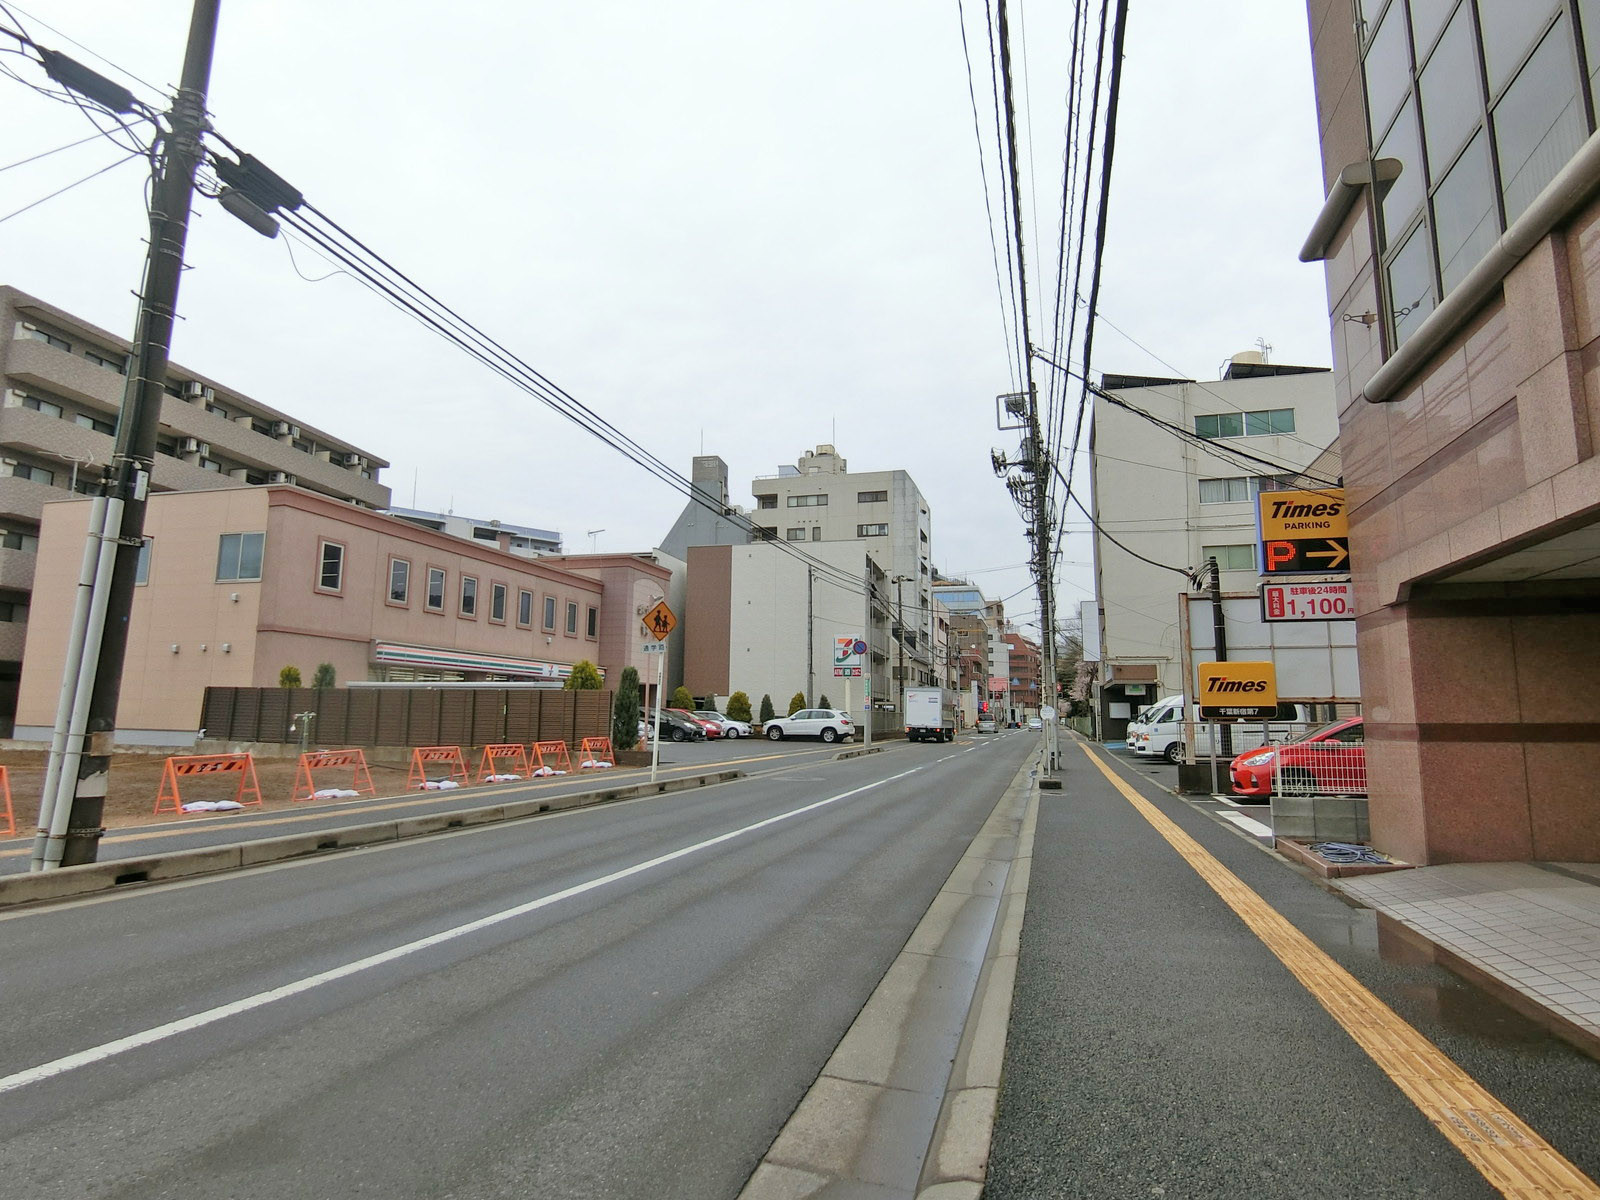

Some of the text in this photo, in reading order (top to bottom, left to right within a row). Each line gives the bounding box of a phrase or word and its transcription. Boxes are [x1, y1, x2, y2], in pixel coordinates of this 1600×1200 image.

[1271, 501, 1343, 519] Times
[1284, 521, 1331, 530] PARKING
[1267, 541, 1296, 571] P
[1290, 586, 1347, 595] 駐車後24時間
[1207, 676, 1268, 693] Times
